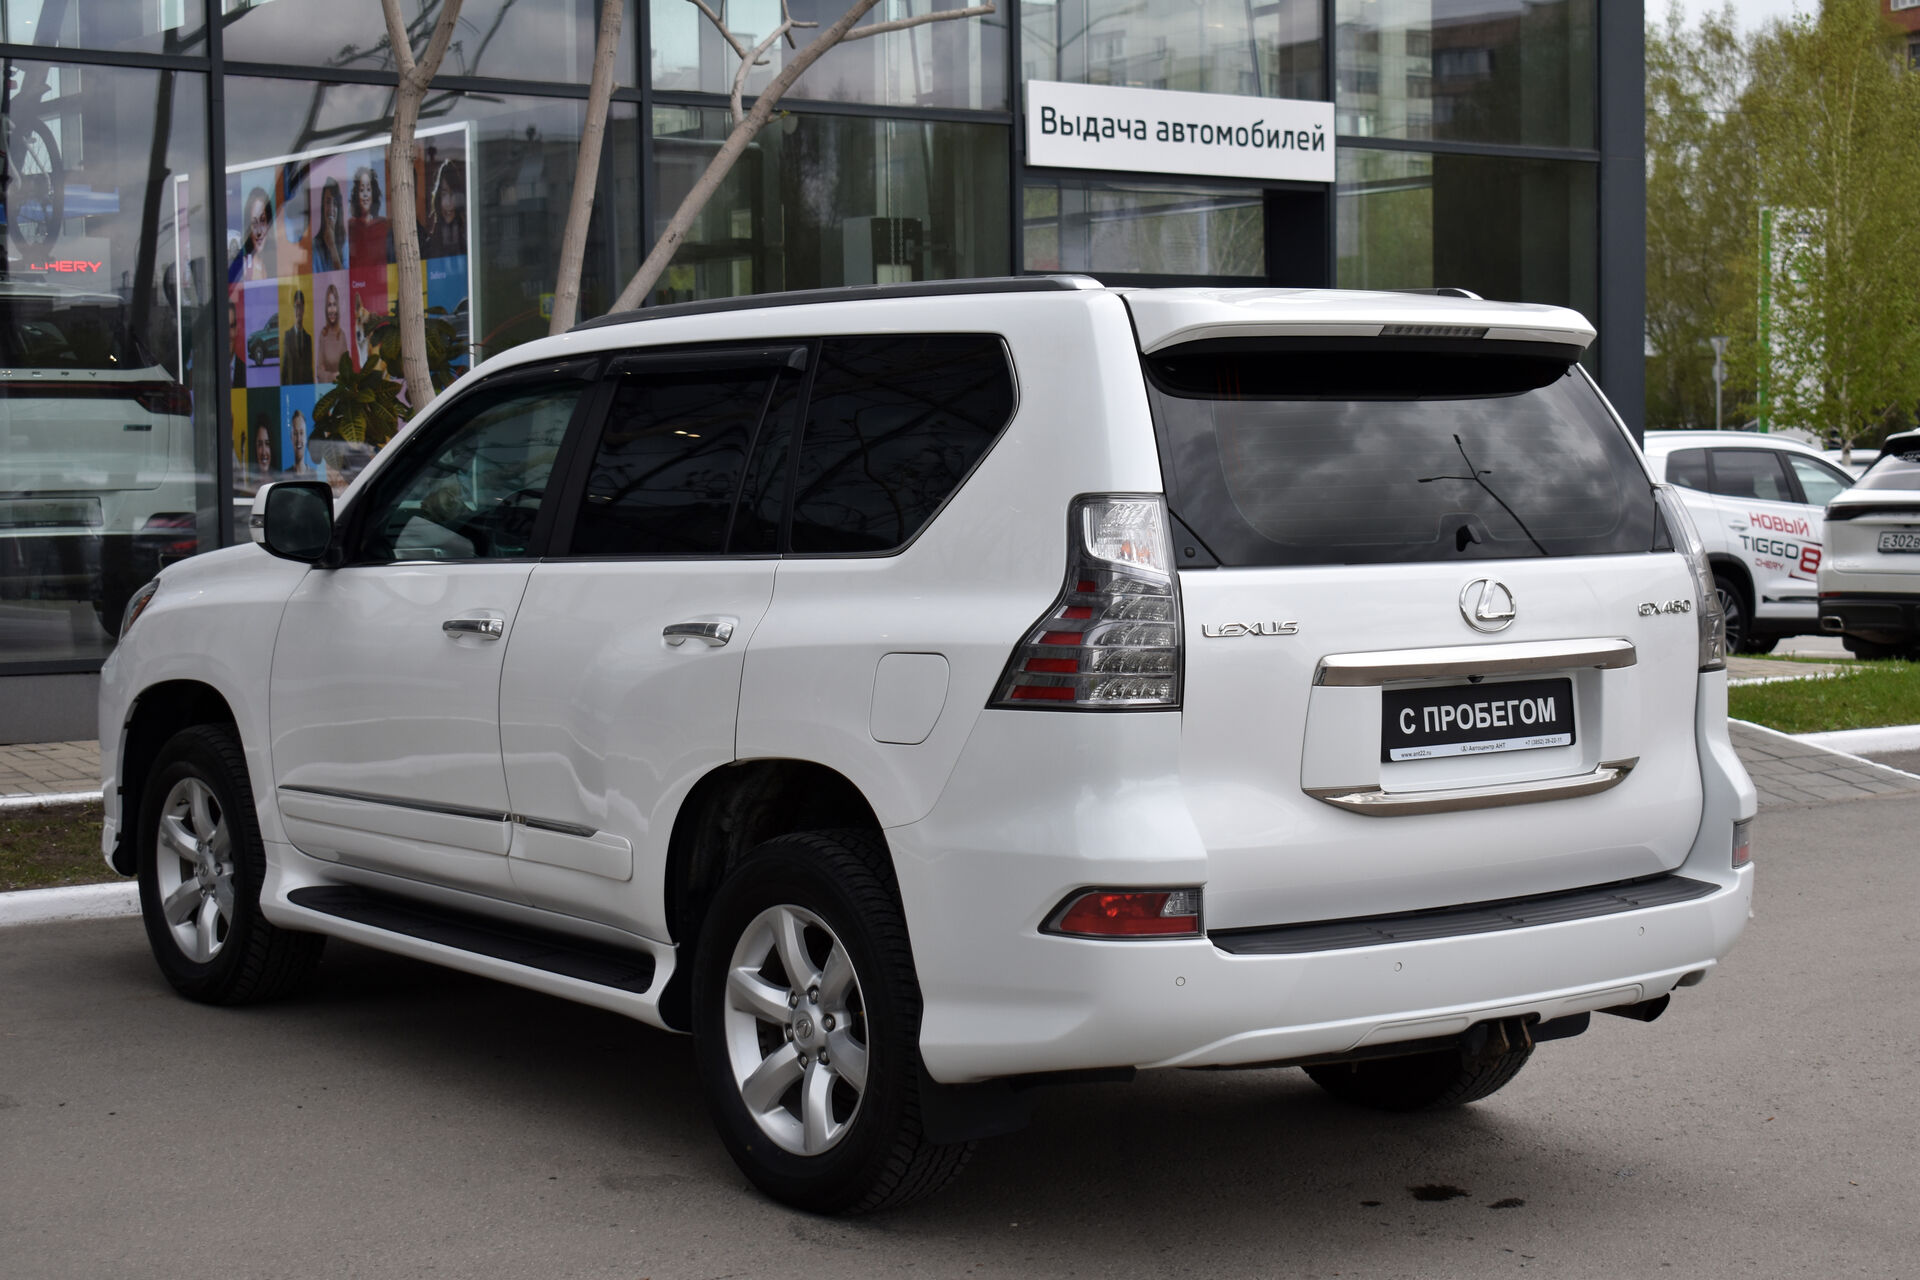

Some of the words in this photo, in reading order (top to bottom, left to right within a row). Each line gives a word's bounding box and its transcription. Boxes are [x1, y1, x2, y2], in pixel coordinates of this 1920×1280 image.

[1041, 106, 1147, 143] Выдача
[1156, 120, 1325, 152] автомобилей
[1749, 511, 1810, 537] НОВЫЙ
[1739, 535, 1799, 560] TIGGO
[1799, 546, 1822, 575] 8
[1755, 557, 1785, 571] CHERY
[1202, 620, 1299, 638] LEXUS
[1400, 707, 1417, 735] С
[1423, 697, 1557, 733] ПРОБЕГОМ
